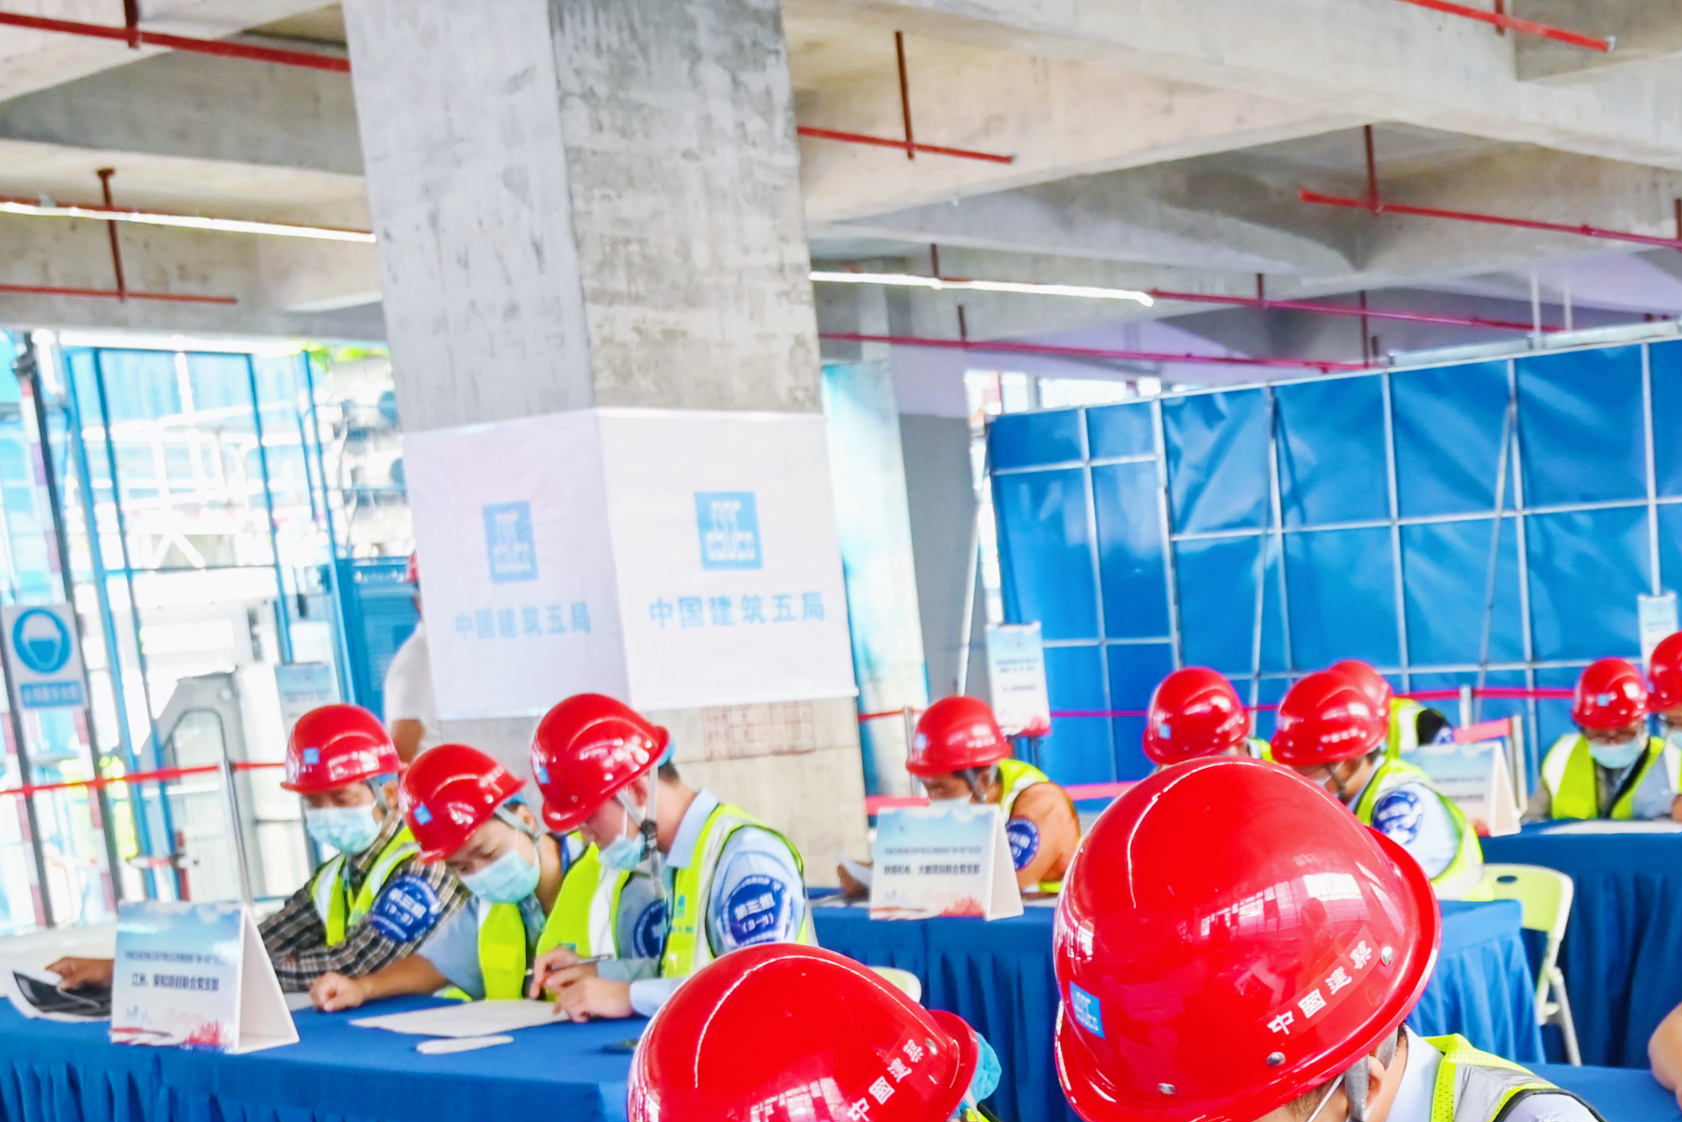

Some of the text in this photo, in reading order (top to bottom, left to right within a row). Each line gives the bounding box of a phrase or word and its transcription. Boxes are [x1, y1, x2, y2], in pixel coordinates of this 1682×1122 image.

[454, 601, 592, 641] 中国建筑五局
[649, 592, 826, 631] 中国建筑五局
